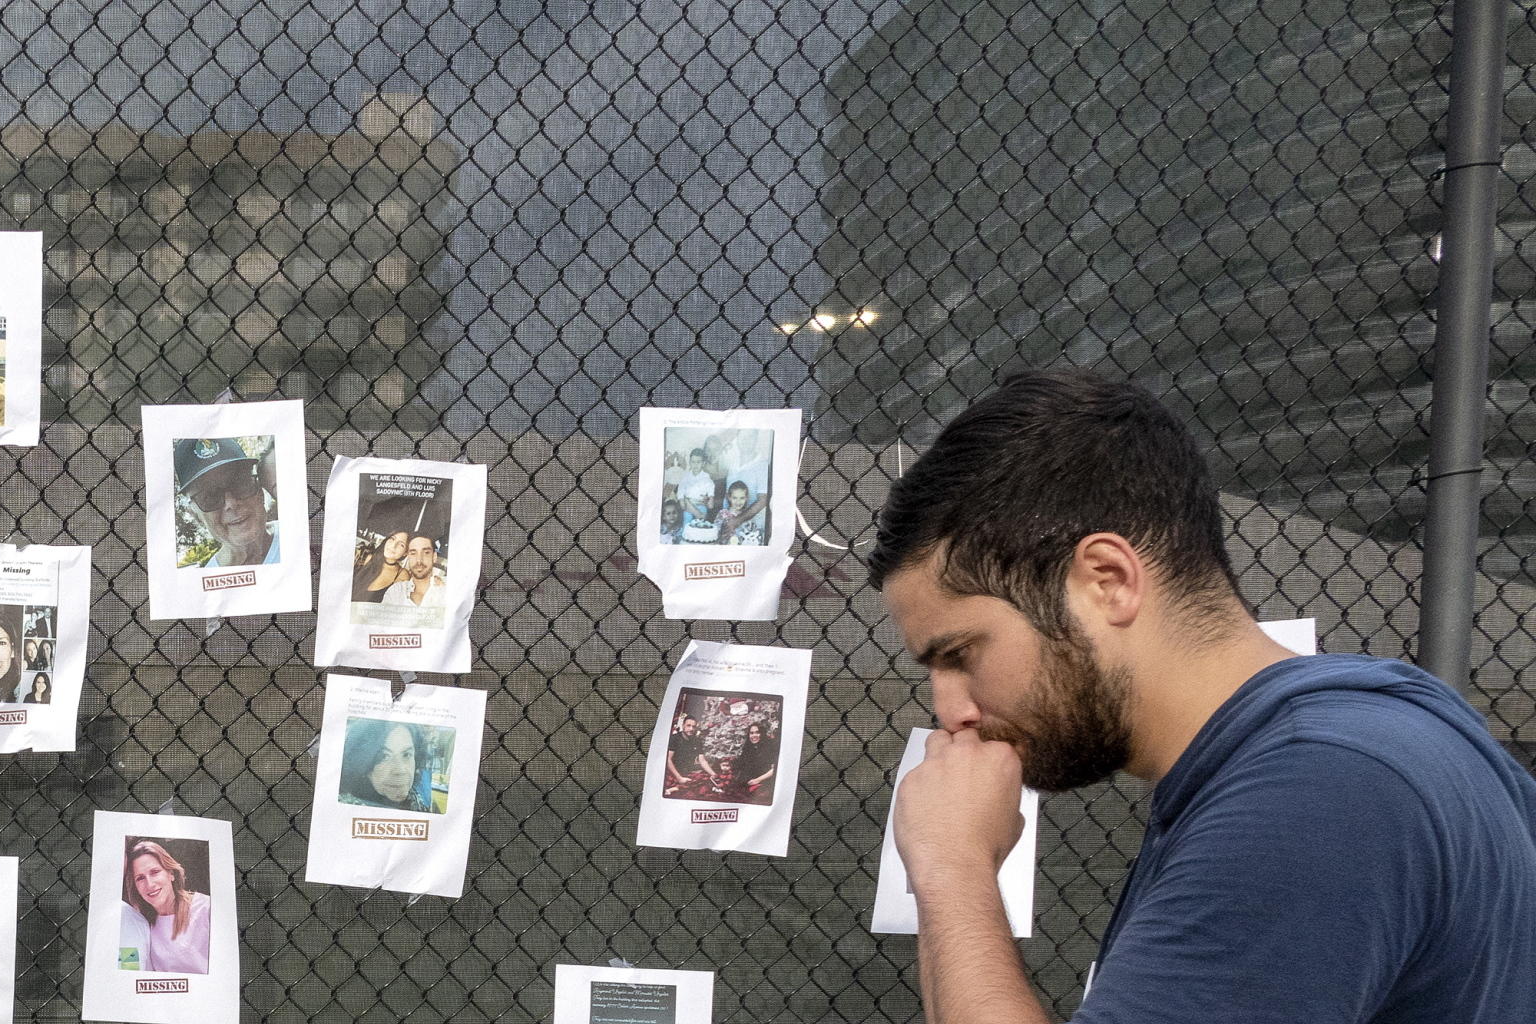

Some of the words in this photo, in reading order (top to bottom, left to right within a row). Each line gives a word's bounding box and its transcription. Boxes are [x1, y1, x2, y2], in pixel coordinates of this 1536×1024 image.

[2, 567, 31, 575] Missing
[688, 563, 743, 577] MISSING
[205, 574, 254, 588] MISSING
[371, 636, 419, 647] MISSING
[694, 810, 736, 821] MISSING
[356, 822, 425, 837] MISSING
[139, 981, 186, 991] MISSING
